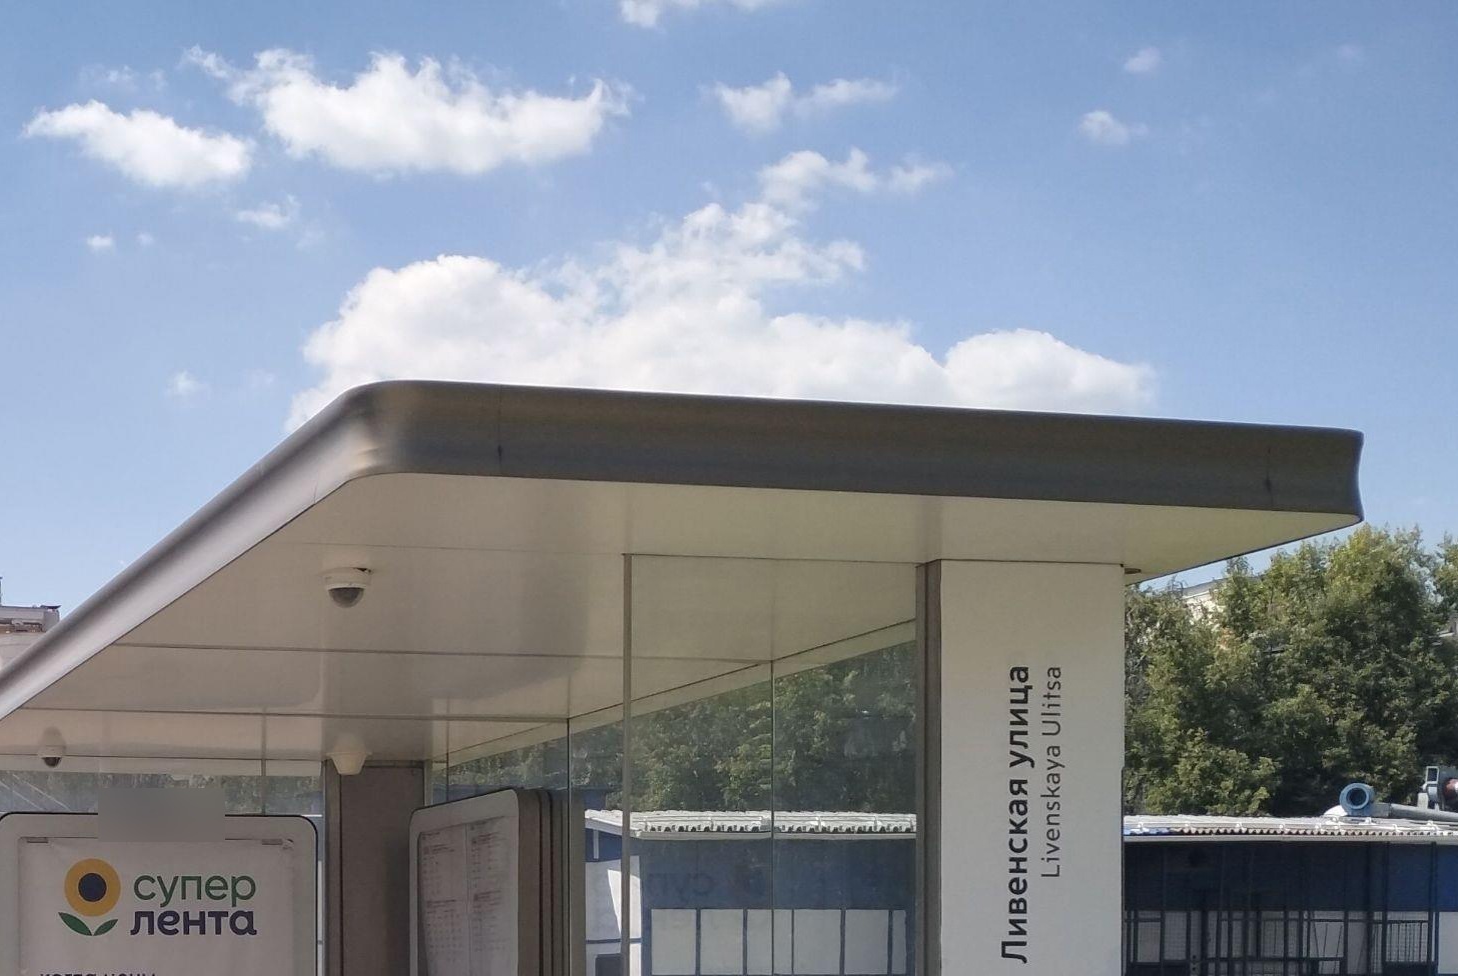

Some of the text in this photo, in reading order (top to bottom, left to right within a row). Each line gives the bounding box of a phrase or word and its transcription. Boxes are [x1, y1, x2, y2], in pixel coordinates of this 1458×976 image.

[1001, 665, 1035, 964] Ливенская улица
[1040, 665, 1066, 878] Livenskaya Ulitsa
[129, 909, 257, 936] лента
[133, 874, 256, 907] супер
